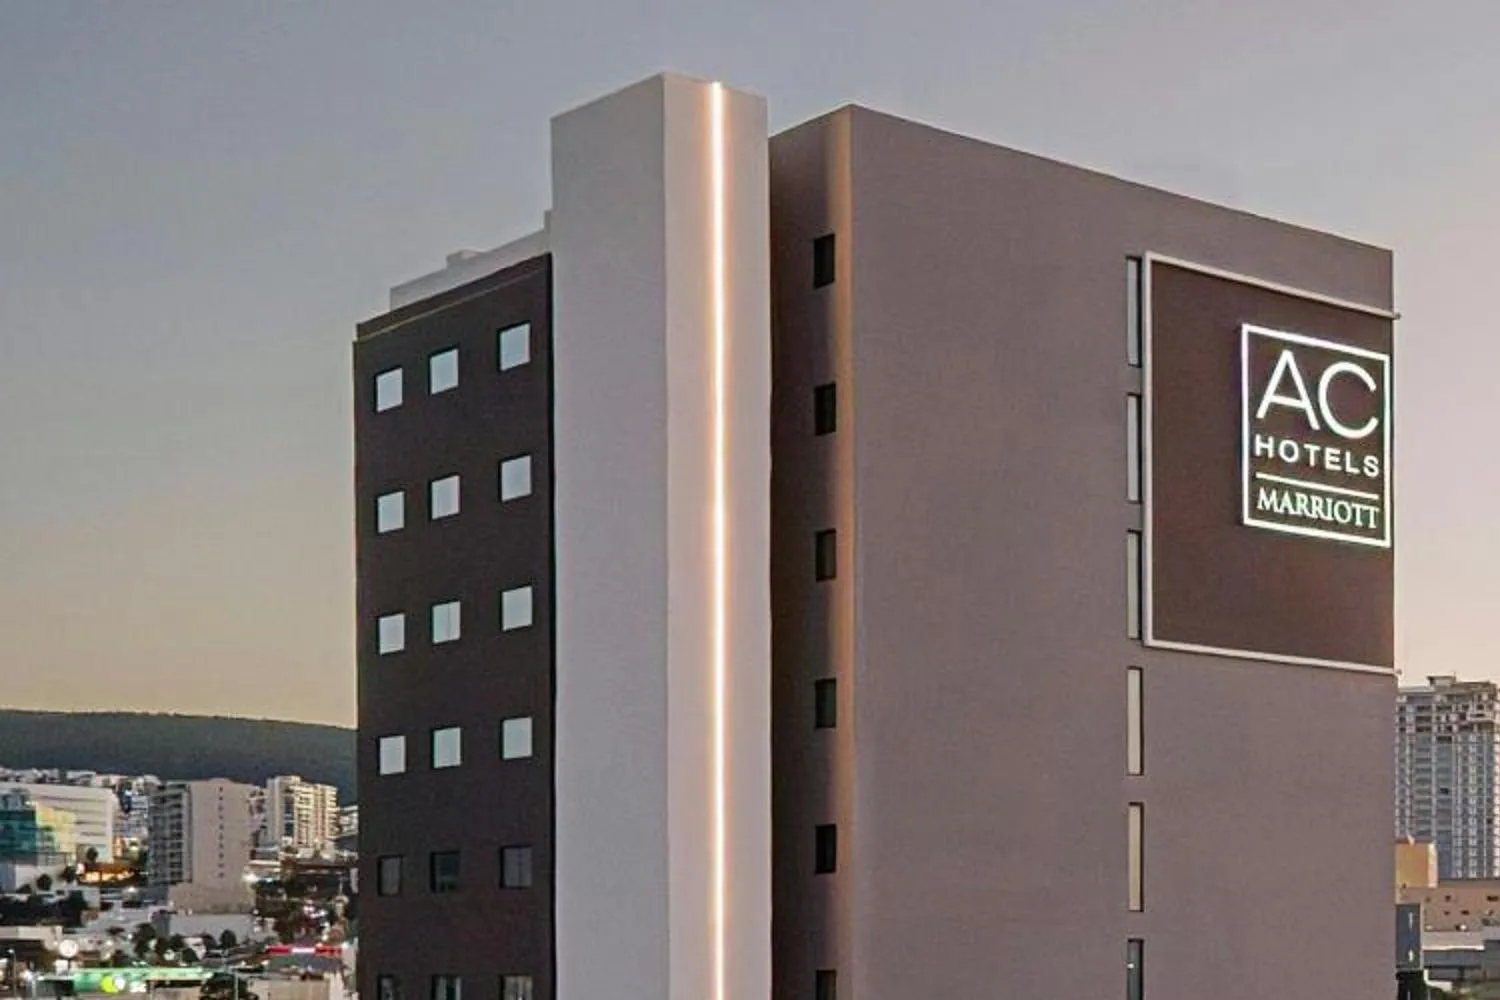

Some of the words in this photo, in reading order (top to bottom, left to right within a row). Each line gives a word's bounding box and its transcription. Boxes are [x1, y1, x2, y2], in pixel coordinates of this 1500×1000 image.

[1256, 350, 1379, 439] AC
[1254, 434, 1380, 477] HOTELS
[1256, 487, 1380, 529] MARRIOTT
